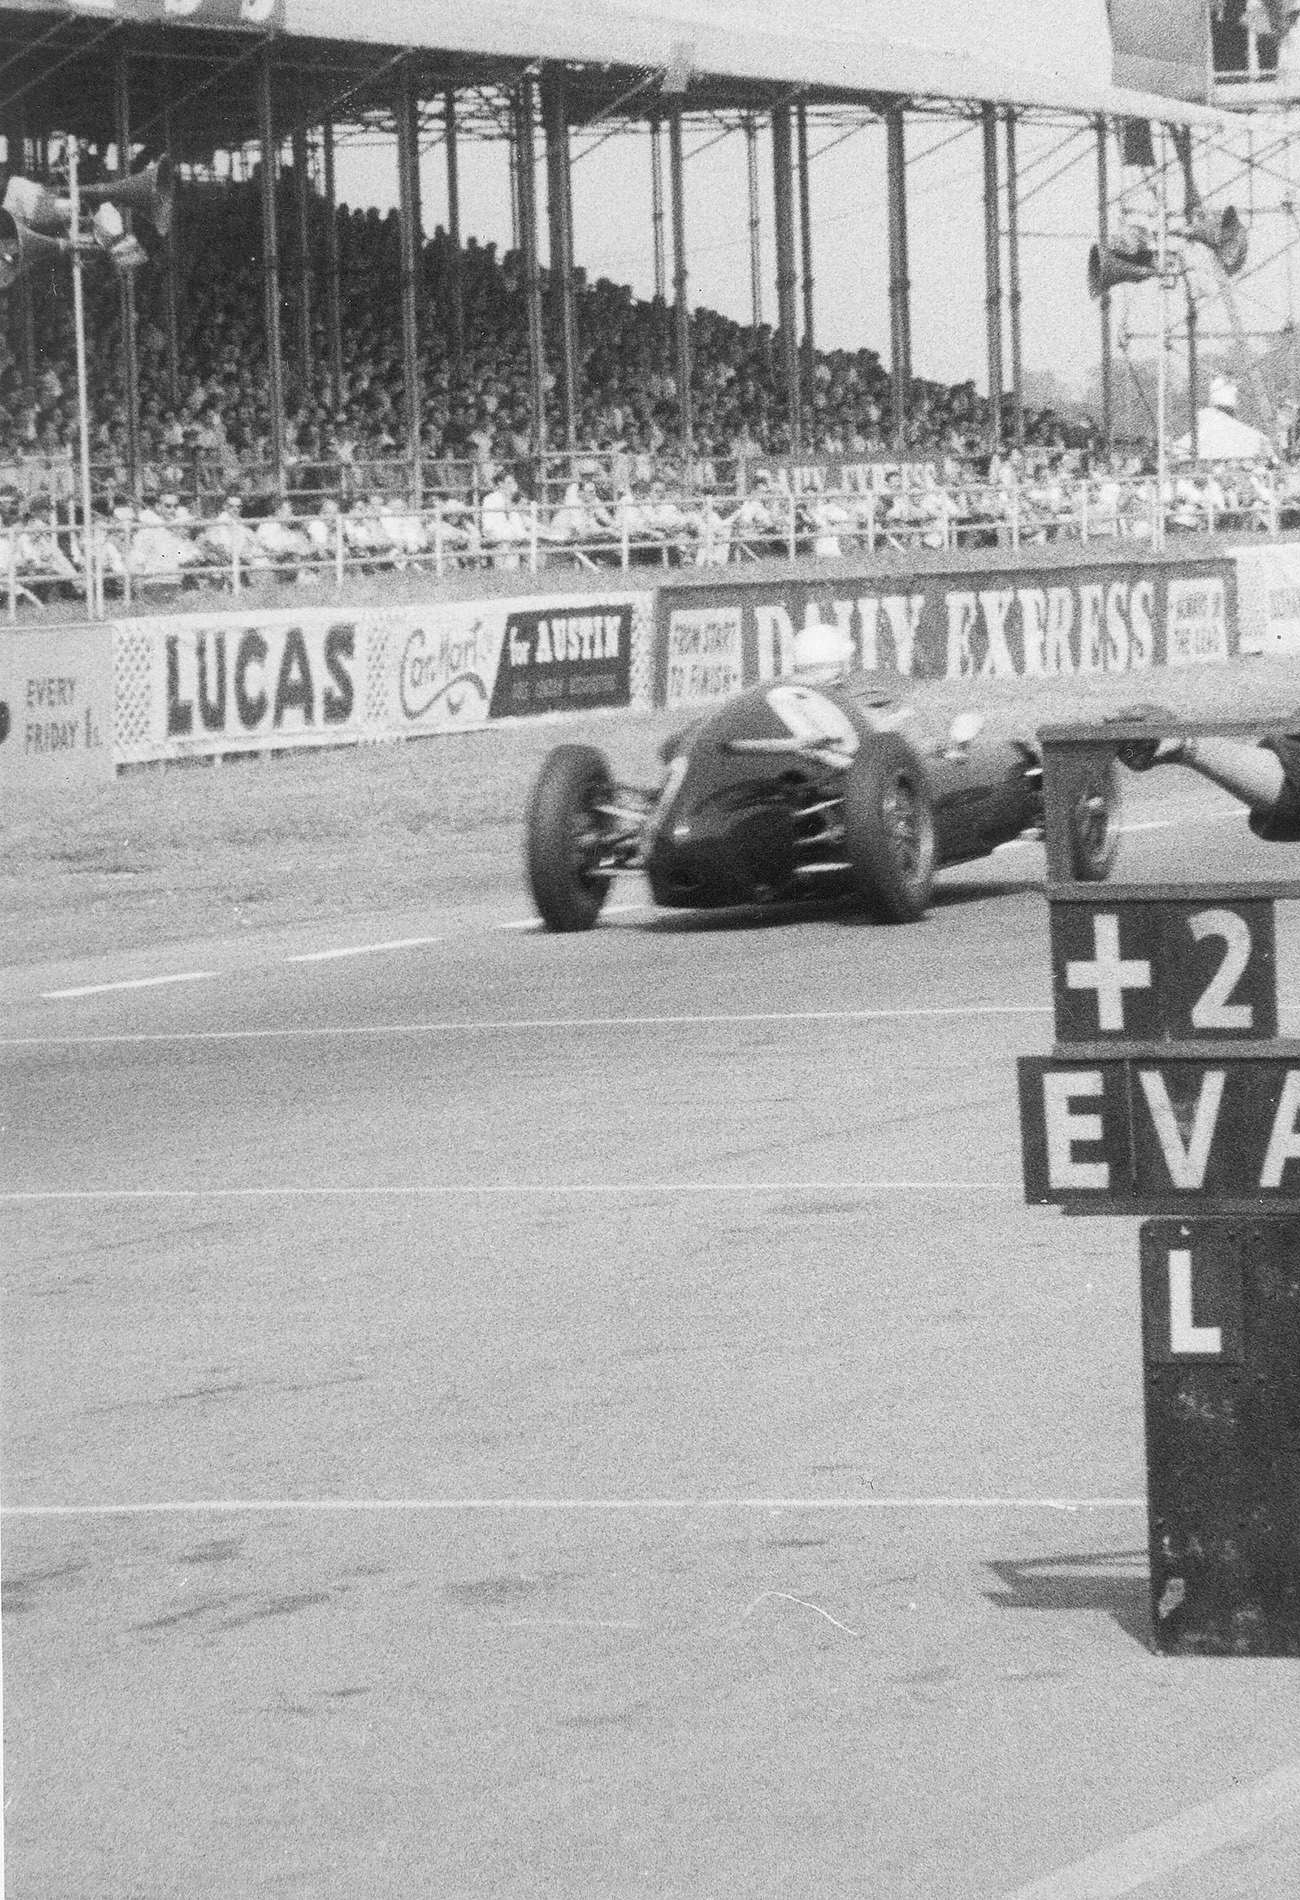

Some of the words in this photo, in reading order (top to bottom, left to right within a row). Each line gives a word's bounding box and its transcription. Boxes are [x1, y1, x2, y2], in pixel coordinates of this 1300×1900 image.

[535, 615, 622, 664] AUSTIN
[946, 582, 1153, 679] EXPRESS
[26, 678, 76, 708] EVERY
[165, 622, 357, 736] LUCAS
[24, 720, 79, 755] FRIDAY
[1168, 1249, 1223, 1354] L
